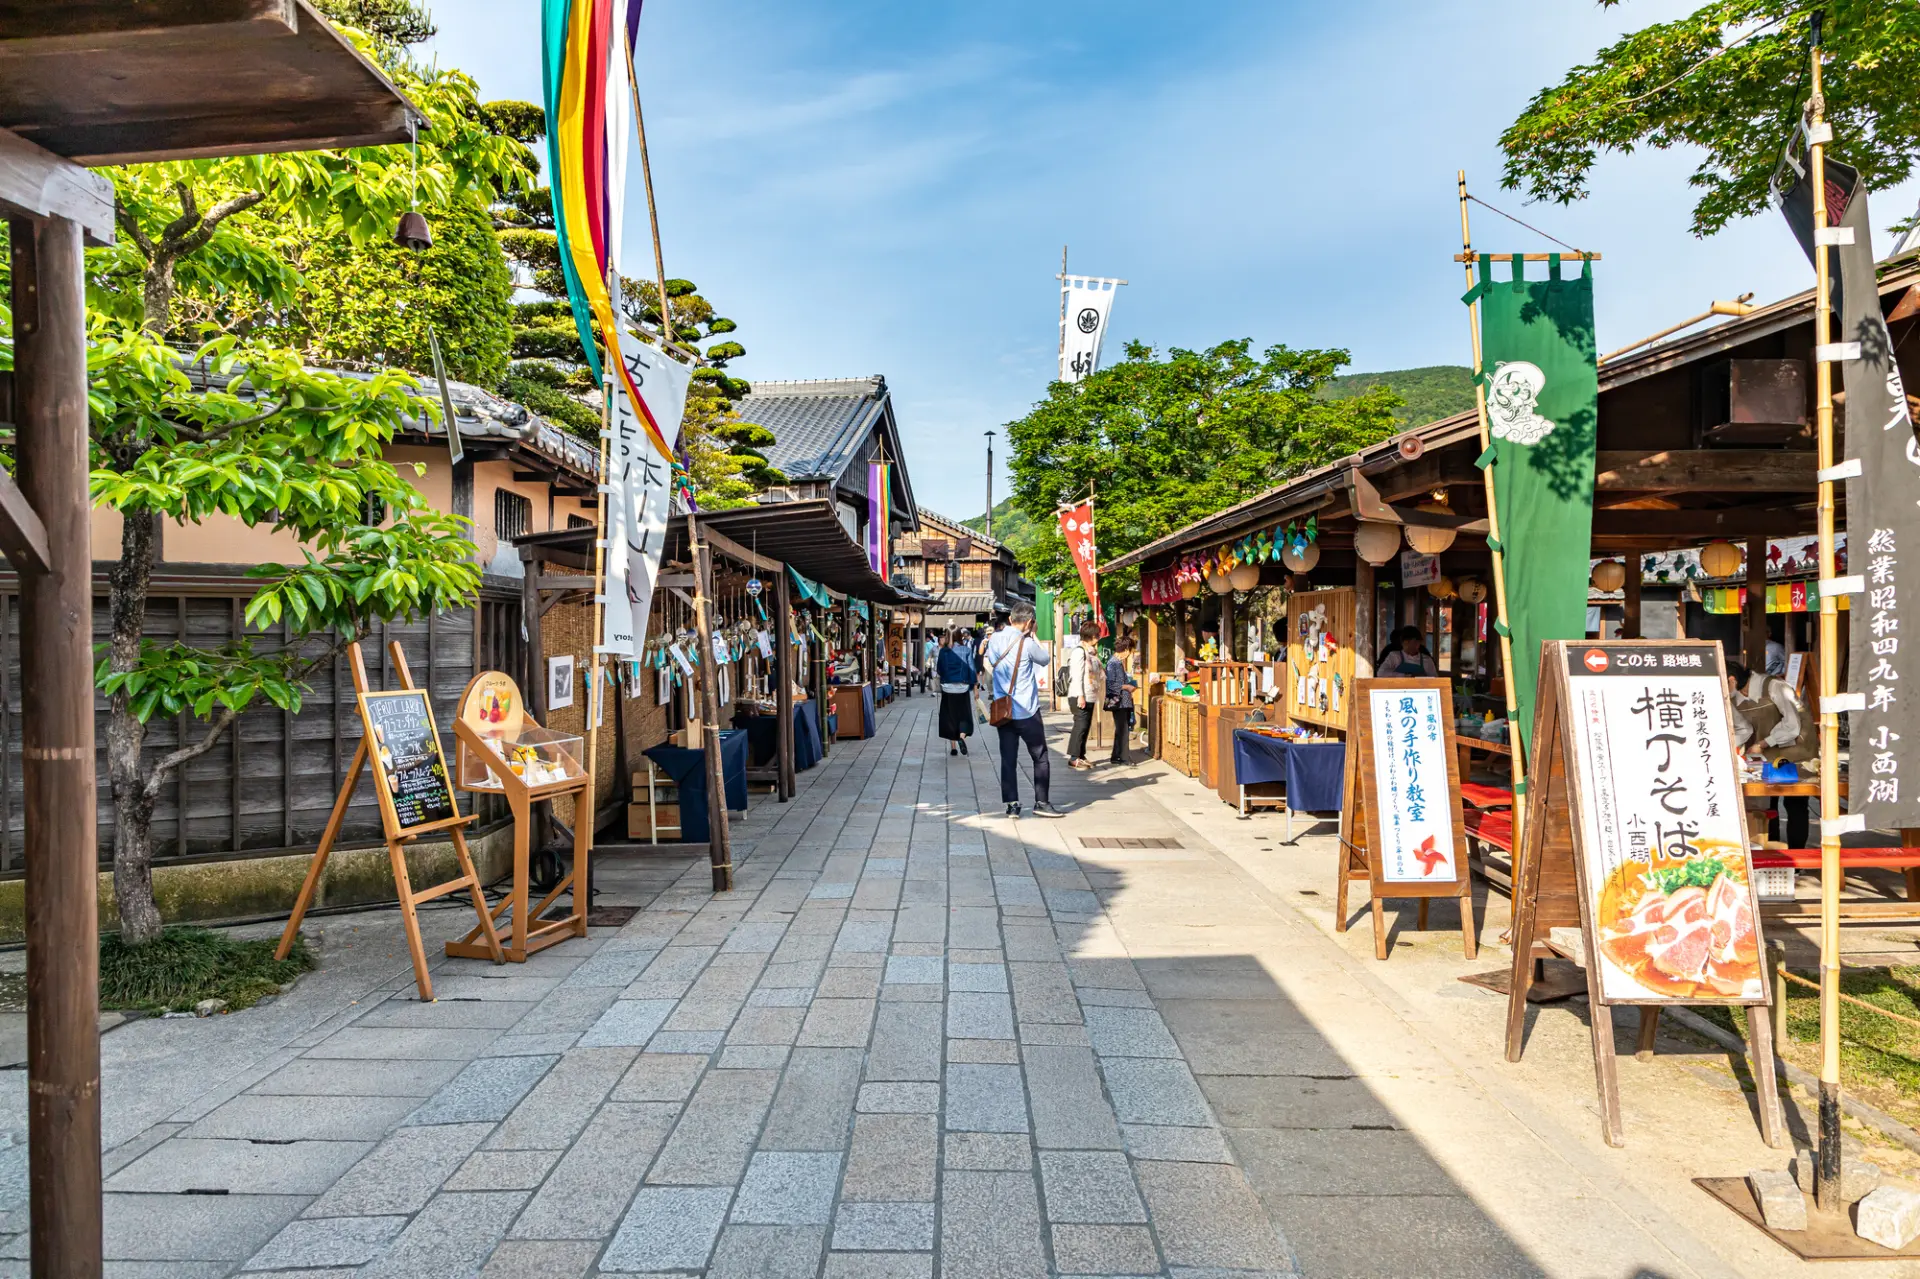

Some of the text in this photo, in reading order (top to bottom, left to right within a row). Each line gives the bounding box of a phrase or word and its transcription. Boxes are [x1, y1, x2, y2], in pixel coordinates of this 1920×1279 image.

[1616, 654, 1702, 668] この先 路地奥
[1398, 697, 1426, 822] 風の手作り教室
[1630, 686, 1700, 860] 横丁そば
[1691, 691, 1720, 817] 路地裏のラーメン屋
[1867, 726, 1900, 803] 小西湖
